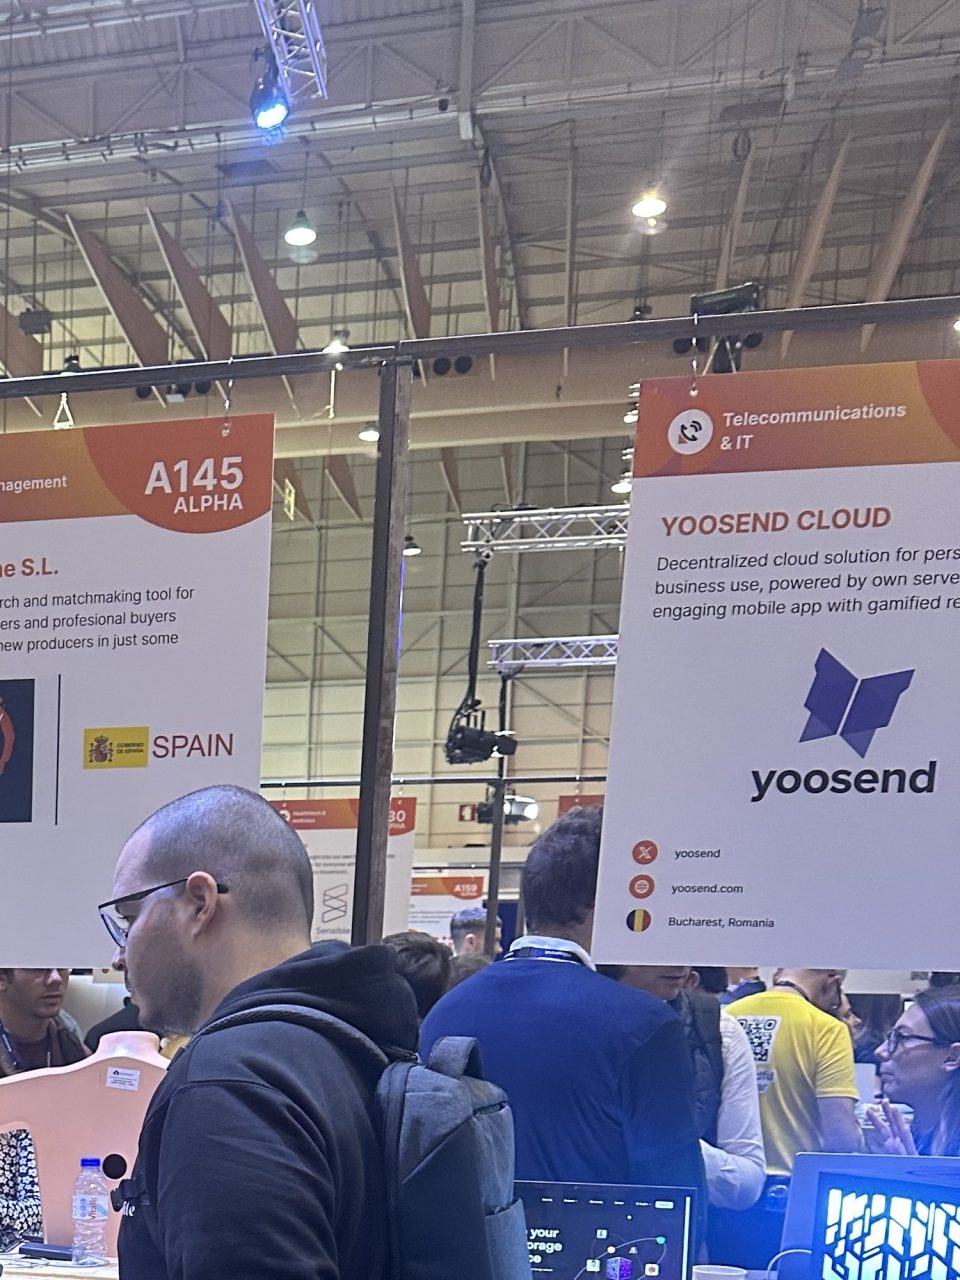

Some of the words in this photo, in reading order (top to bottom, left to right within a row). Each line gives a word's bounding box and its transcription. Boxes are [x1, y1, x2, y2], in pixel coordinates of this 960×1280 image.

[723, 404, 907, 427] Telecommunications
[720, 436, 732, 450] &
[736, 434, 754, 449] IT
[144, 456, 243, 495] A145
[174, 494, 243, 514] ALPHA
[661, 511, 789, 537] YOOSEND
[797, 506, 891, 532] CLOUD
[21, 558, 59, 577] S.L.
[657, 553, 768, 571] Decentralized
[773, 551, 818, 567] cloud
[823, 549, 890, 565] solution
[896, 547, 918, 562] for
[924, 548, 960, 564] pers
[655, 579, 725, 595] business
[730, 579, 764, 595] use,
[769, 576, 842, 593] powered
[847, 574, 866, 591] by
[872, 575, 907, 587] own
[24, 593, 48, 608] and
[52, 589, 141, 608] matchmaking
[145, 587, 172, 601] tool
[176, 586, 195, 600] for
[653, 602, 726, 620] engaging
[732, 601, 786, 616] mobile
[791, 602, 822, 618] app
[828, 598, 862, 613] with
[867, 595, 941, 614] gamified
[24, 615, 48, 630] and
[53, 611, 127, 630] profesional
[130, 610, 176, 628] buyers
[27, 635, 94, 653] producers
[98, 634, 109, 648] in
[112, 632, 138, 650] just
[141, 633, 179, 646] some
[152, 733, 233, 759] SPAIN
[750, 761, 937, 803] yoosend
[389, 810, 406, 823] 30
[674, 847, 720, 861] yoosend
[671, 883, 744, 896] yoosend.com
[668, 917, 726, 929] Bucharest,
[728, 917, 775, 929] Romania
[530, 1229, 559, 1239] your
[527, 1242, 562, 1253] orage
